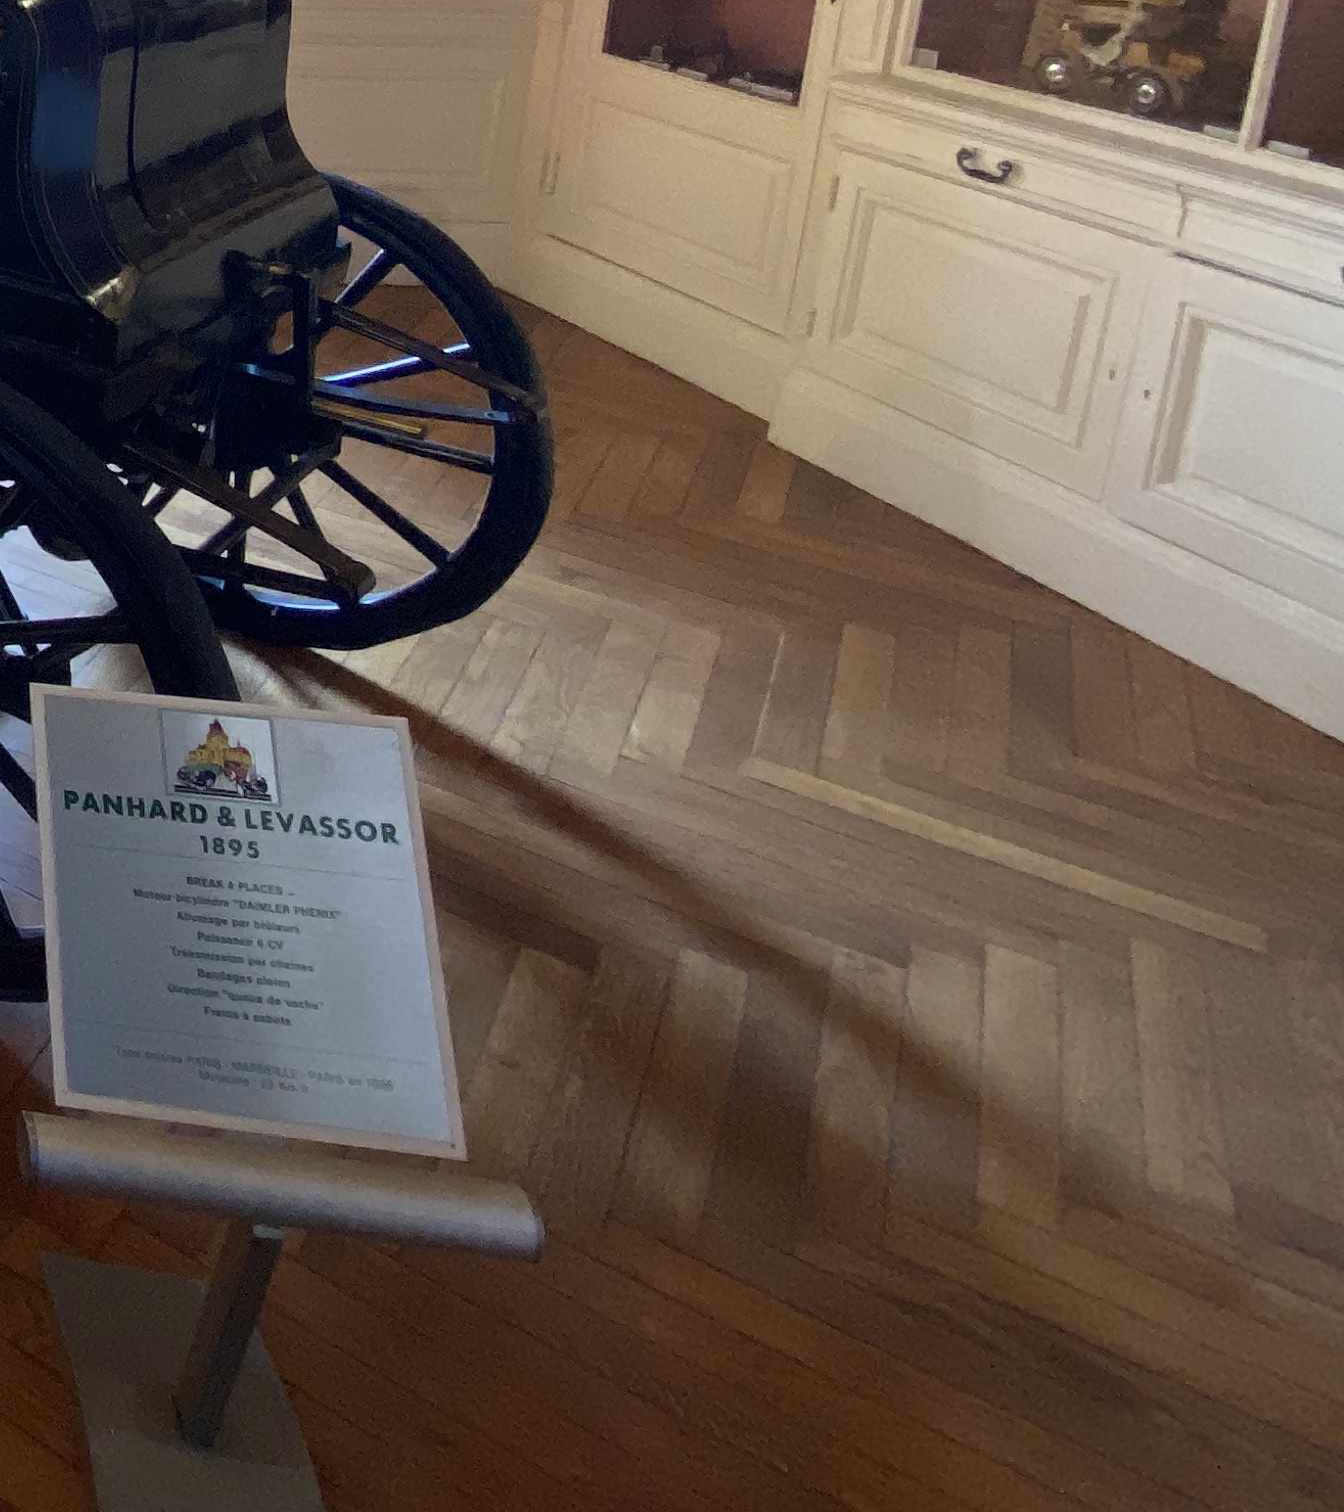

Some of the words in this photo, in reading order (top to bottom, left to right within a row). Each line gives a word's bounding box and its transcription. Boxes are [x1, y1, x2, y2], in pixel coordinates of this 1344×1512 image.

[62, 788, 207, 825] PANHARD
[216, 805, 236, 828] &
[243, 807, 400, 845] LEVASSOR
[199, 835, 260, 859] 1895
[186, 876, 224, 889] BREAK
[238, 881, 283, 895] PLACES
[133, 888, 171, 901] Moteur
[232, 919, 250, 929] par
[268, 939, 283, 949] CV
[248, 957, 266, 967] par
